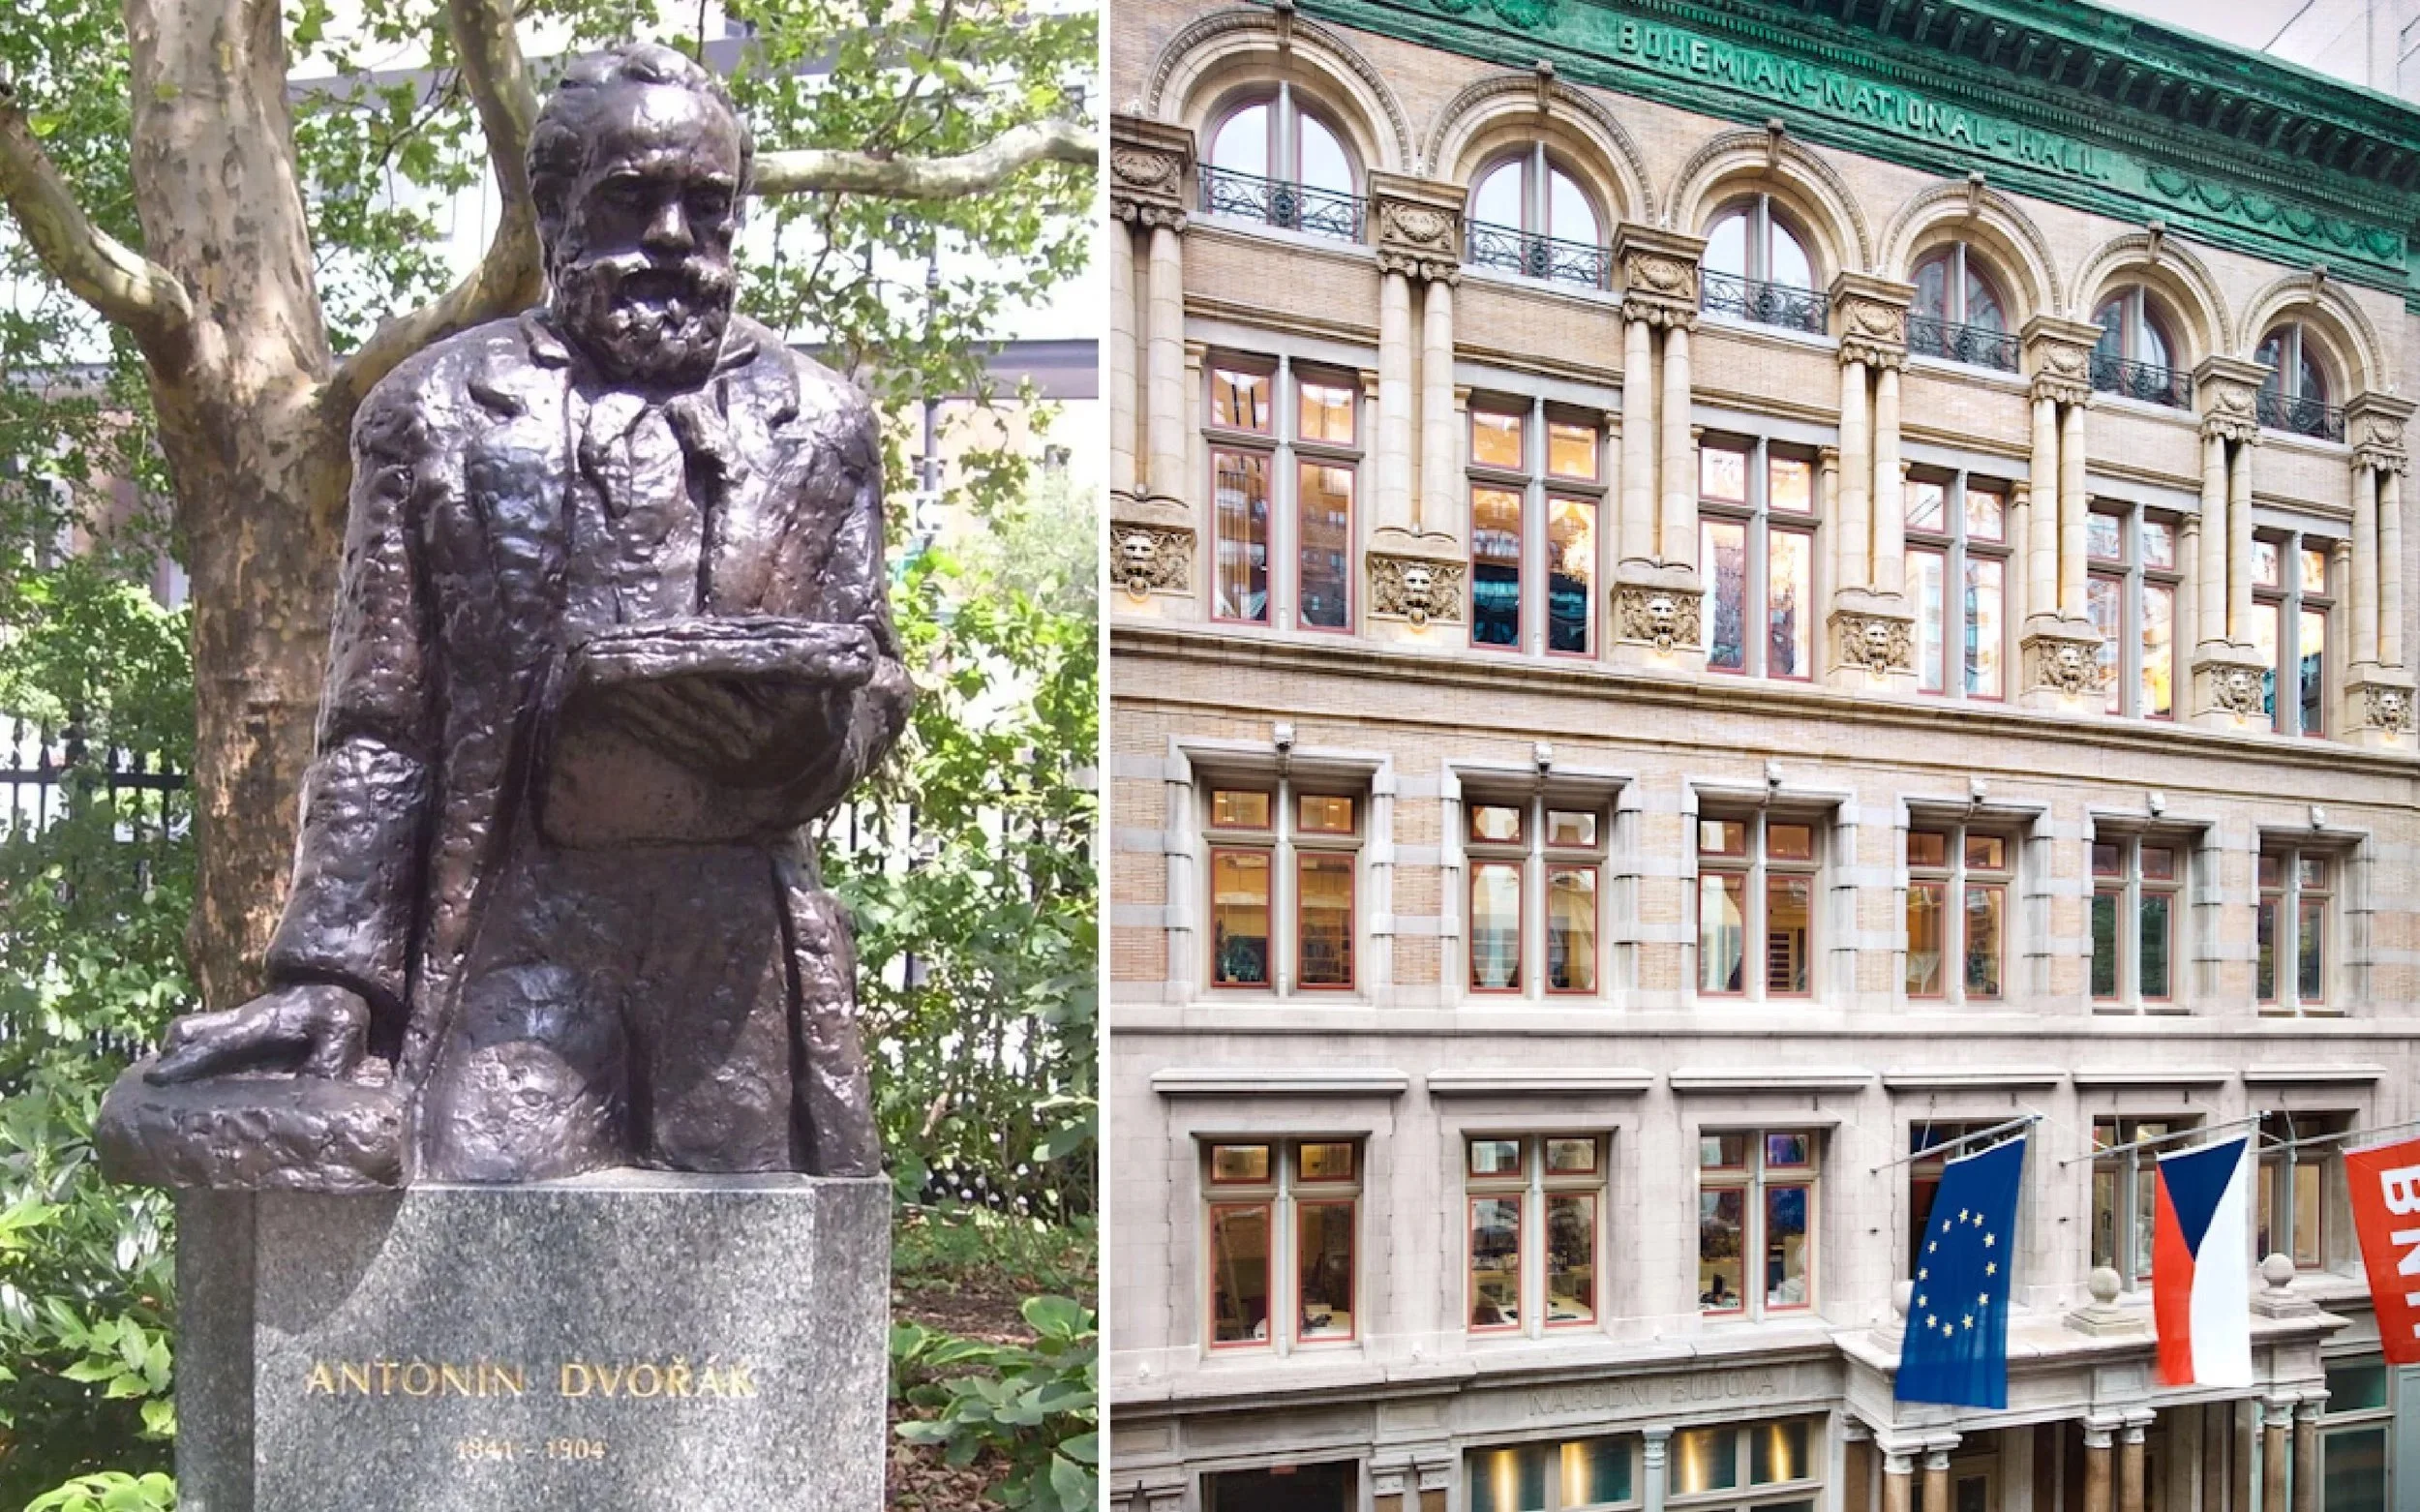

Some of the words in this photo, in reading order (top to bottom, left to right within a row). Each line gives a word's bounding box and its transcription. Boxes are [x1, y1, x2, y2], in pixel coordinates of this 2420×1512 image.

[2379, 1165, 2420, 1339] BN
[560, 1354, 760, 1398] DVOŘÁK
[457, 1437, 514, 1461] 1841
[545, 1437, 607, 1460] 1904
